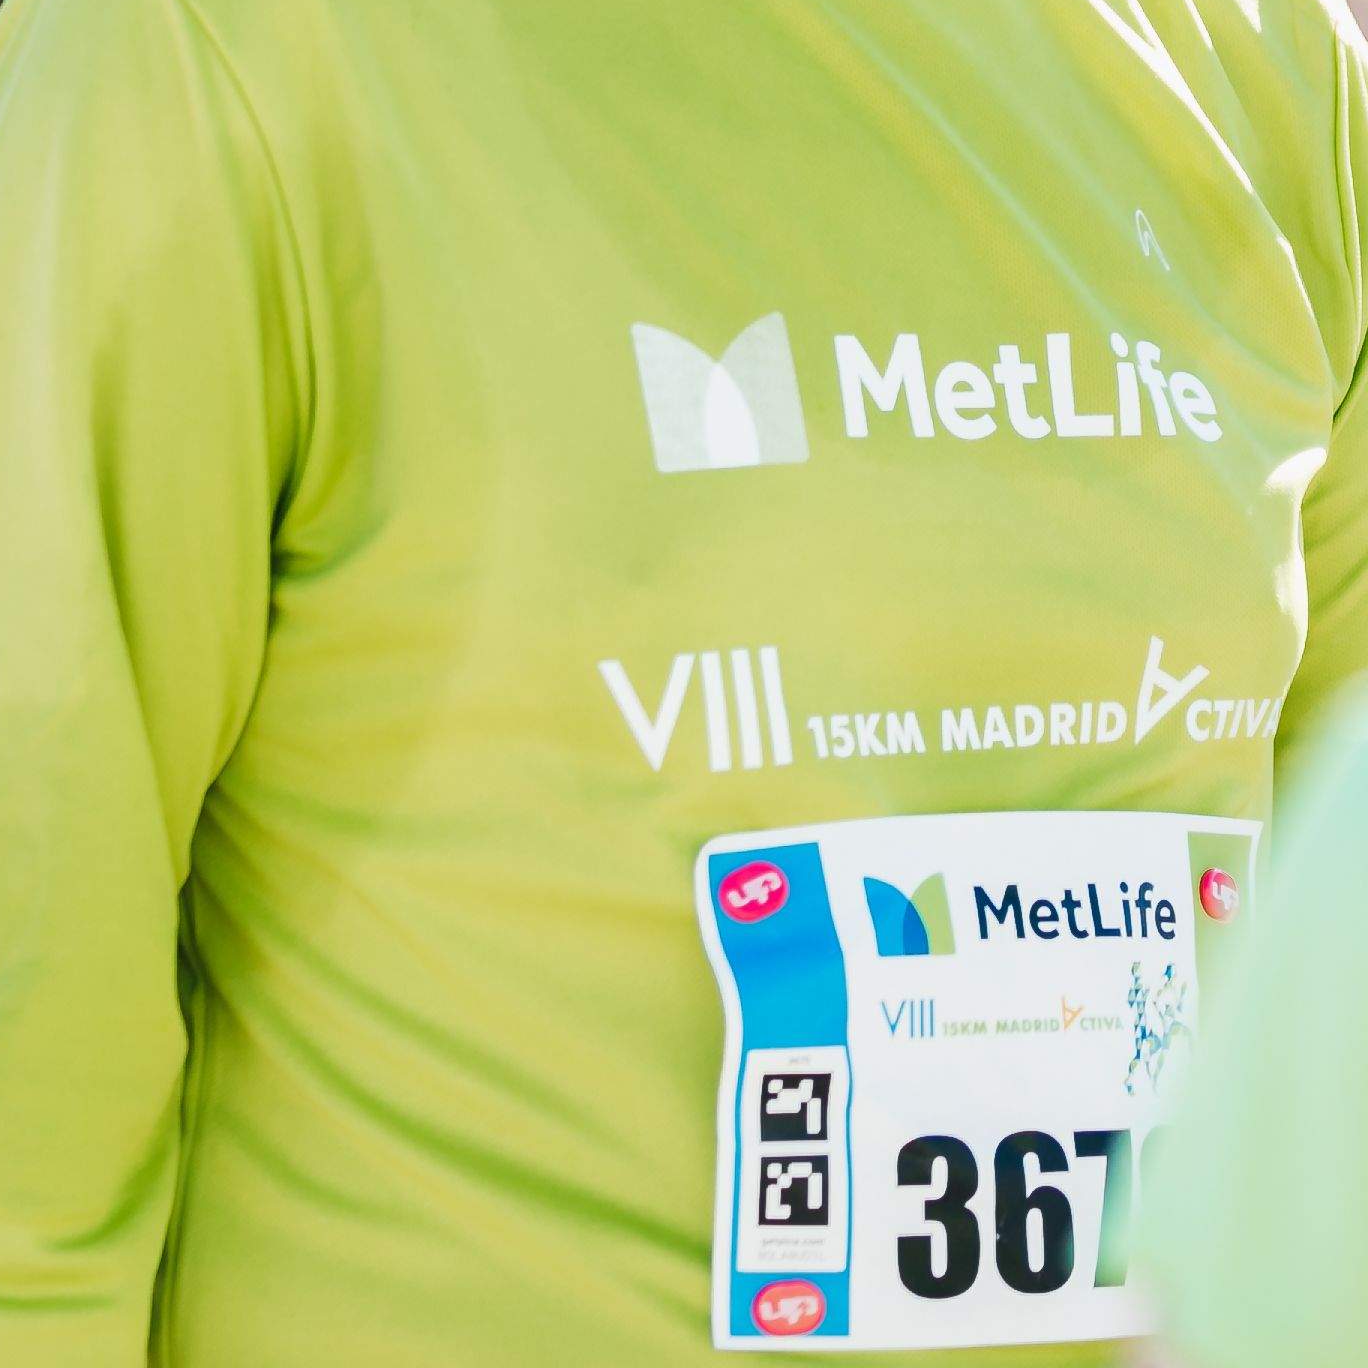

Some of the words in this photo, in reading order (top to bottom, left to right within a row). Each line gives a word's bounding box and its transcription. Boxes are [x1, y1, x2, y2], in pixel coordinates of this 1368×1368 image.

[833, 332, 1223, 442] MetLife
[598, 645, 794, 772] VIII
[807, 711, 926, 758] 15KM
[941, 701, 1128, 752] MADRID
[973, 881, 1176, 940] MetLife
[881, 998, 935, 1039] VIII
[942, 1019, 988, 1037] 15KM
[995, 1017, 1060, 1035] MADRID
[897, 1125, 1174, 1299] 367
